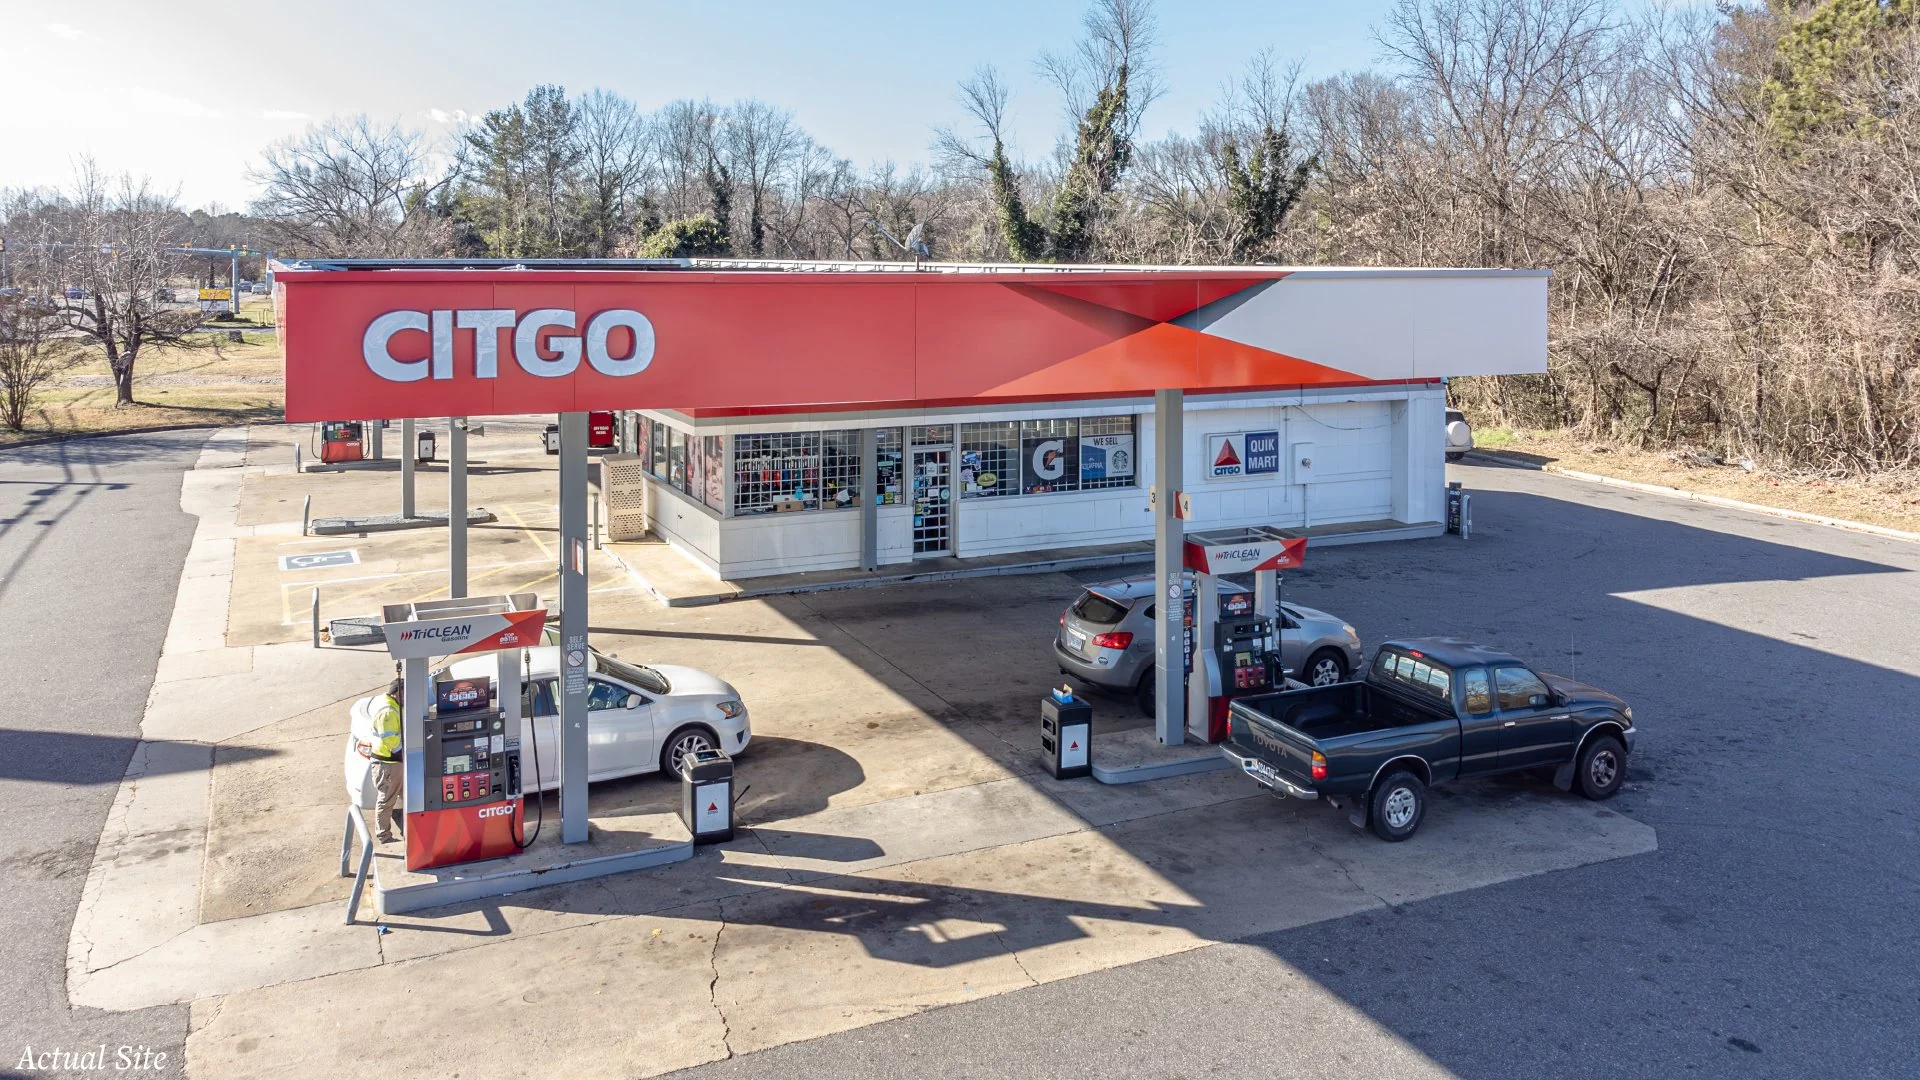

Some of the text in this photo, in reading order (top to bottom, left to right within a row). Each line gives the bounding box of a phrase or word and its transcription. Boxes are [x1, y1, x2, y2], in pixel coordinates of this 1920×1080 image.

[362, 308, 656, 382] CITGO
[1093, 436, 1118, 446] WE SELL
[1250, 439, 1275, 453] QUIK
[1032, 440, 1064, 481] G
[1248, 456, 1277, 469] MART
[1214, 466, 1241, 476] CITGO
[1151, 492, 1156, 504] 3
[1184, 500, 1189, 512] 4
[1223, 548, 1261, 560] TriCLEAN
[413, 624, 472, 640] TriCLEAN
[569, 635, 584, 643] SELF
[1253, 733, 1288, 759] TOYOTA
[478, 805, 514, 818] CITGO
